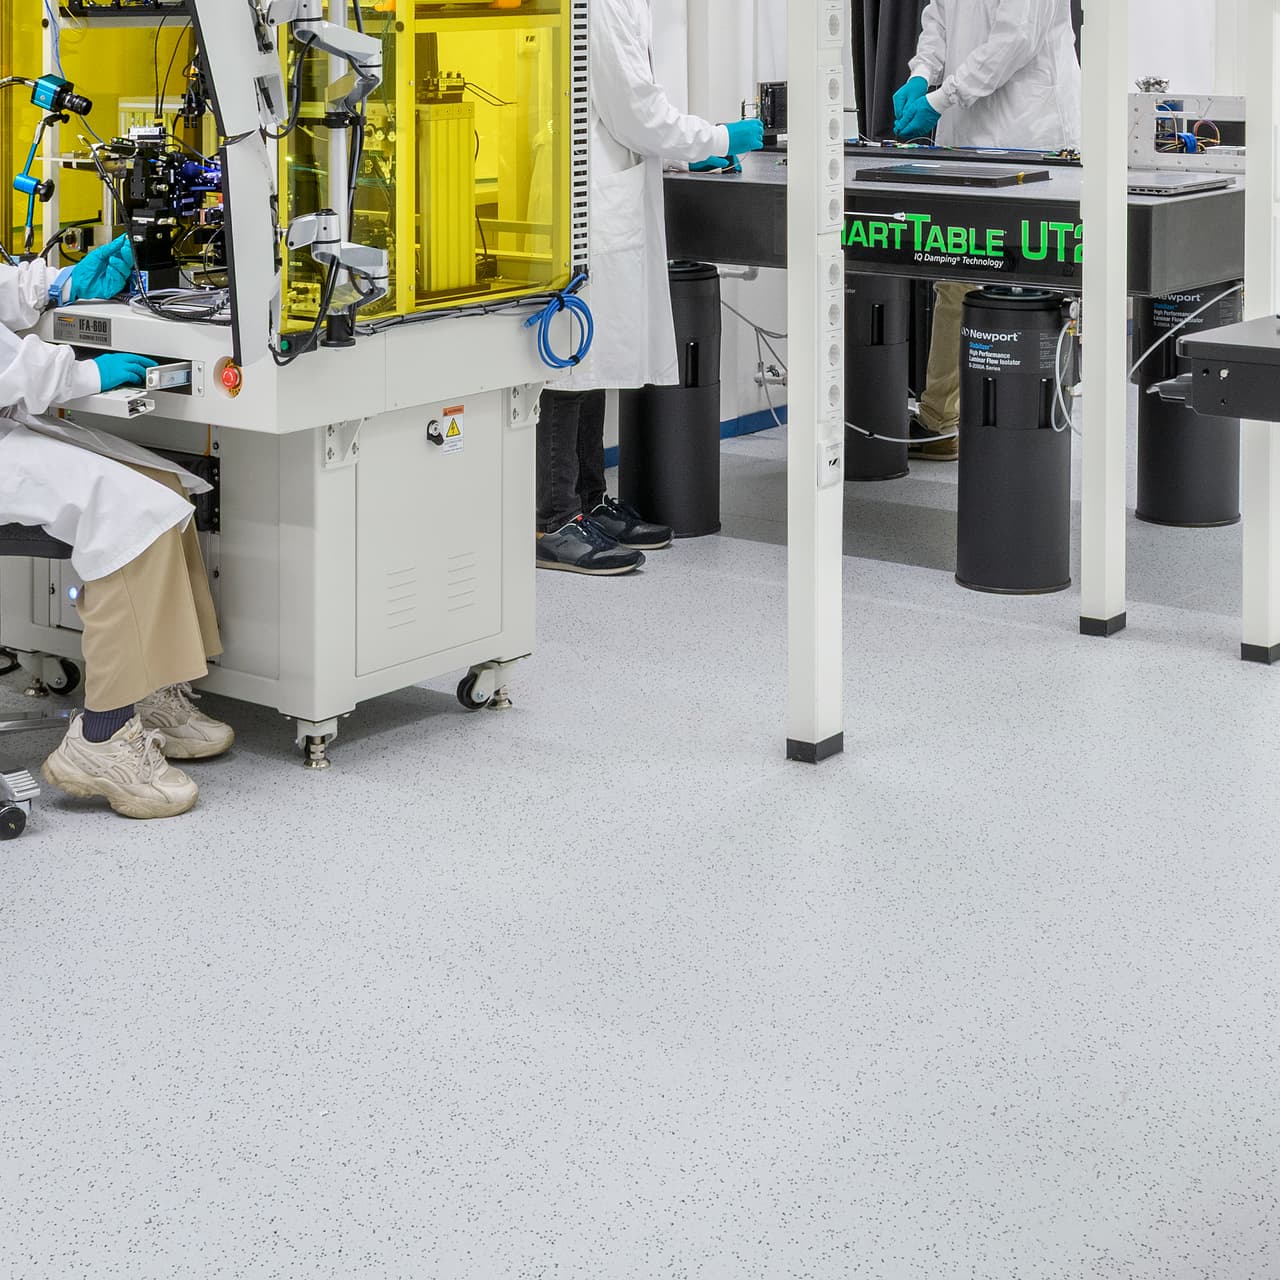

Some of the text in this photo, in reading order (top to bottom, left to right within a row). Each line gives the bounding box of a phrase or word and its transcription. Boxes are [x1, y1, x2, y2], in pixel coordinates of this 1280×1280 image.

[913, 252, 923, 262] IQ
[962, 256, 1004, 268] Technology
[79, 319, 107, 333] IFA-600
